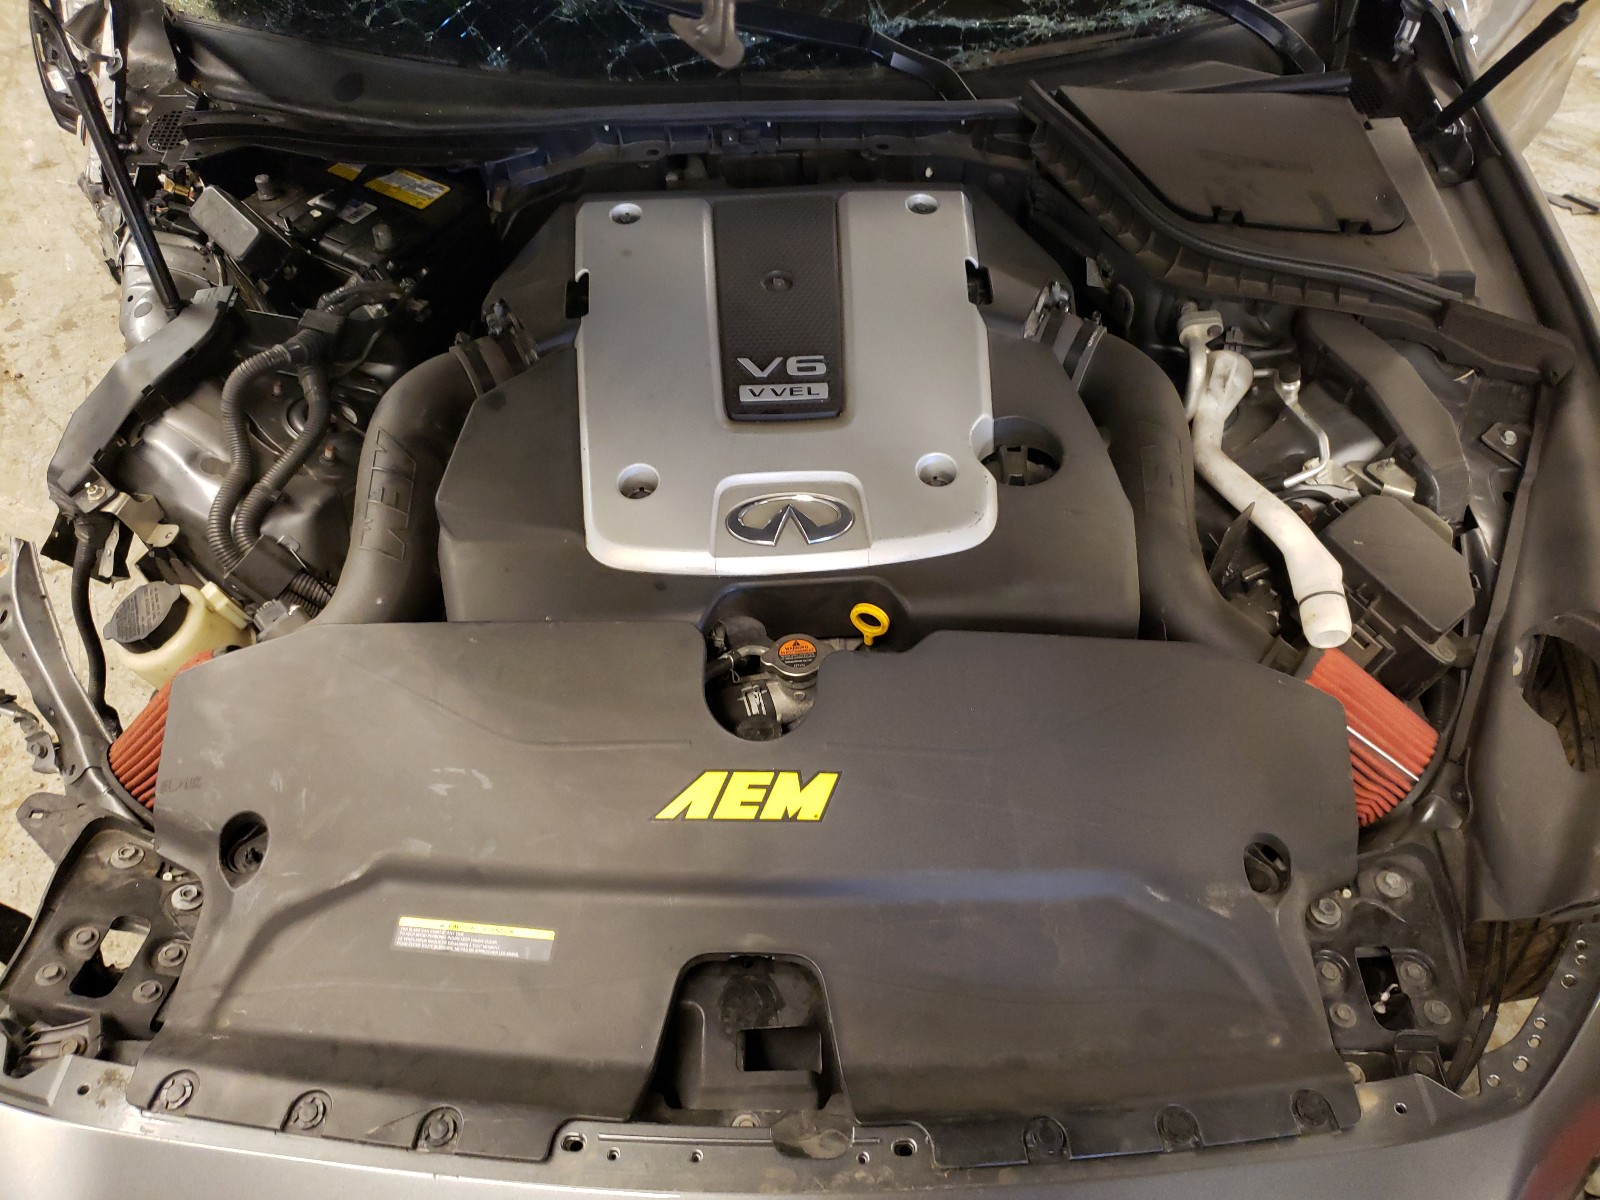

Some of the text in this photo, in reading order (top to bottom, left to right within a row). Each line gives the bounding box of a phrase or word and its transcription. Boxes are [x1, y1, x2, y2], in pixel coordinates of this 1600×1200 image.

[737, 355, 827, 377] V6
[748, 387, 820, 397] VVEL
[652, 769, 840, 821] AEM
